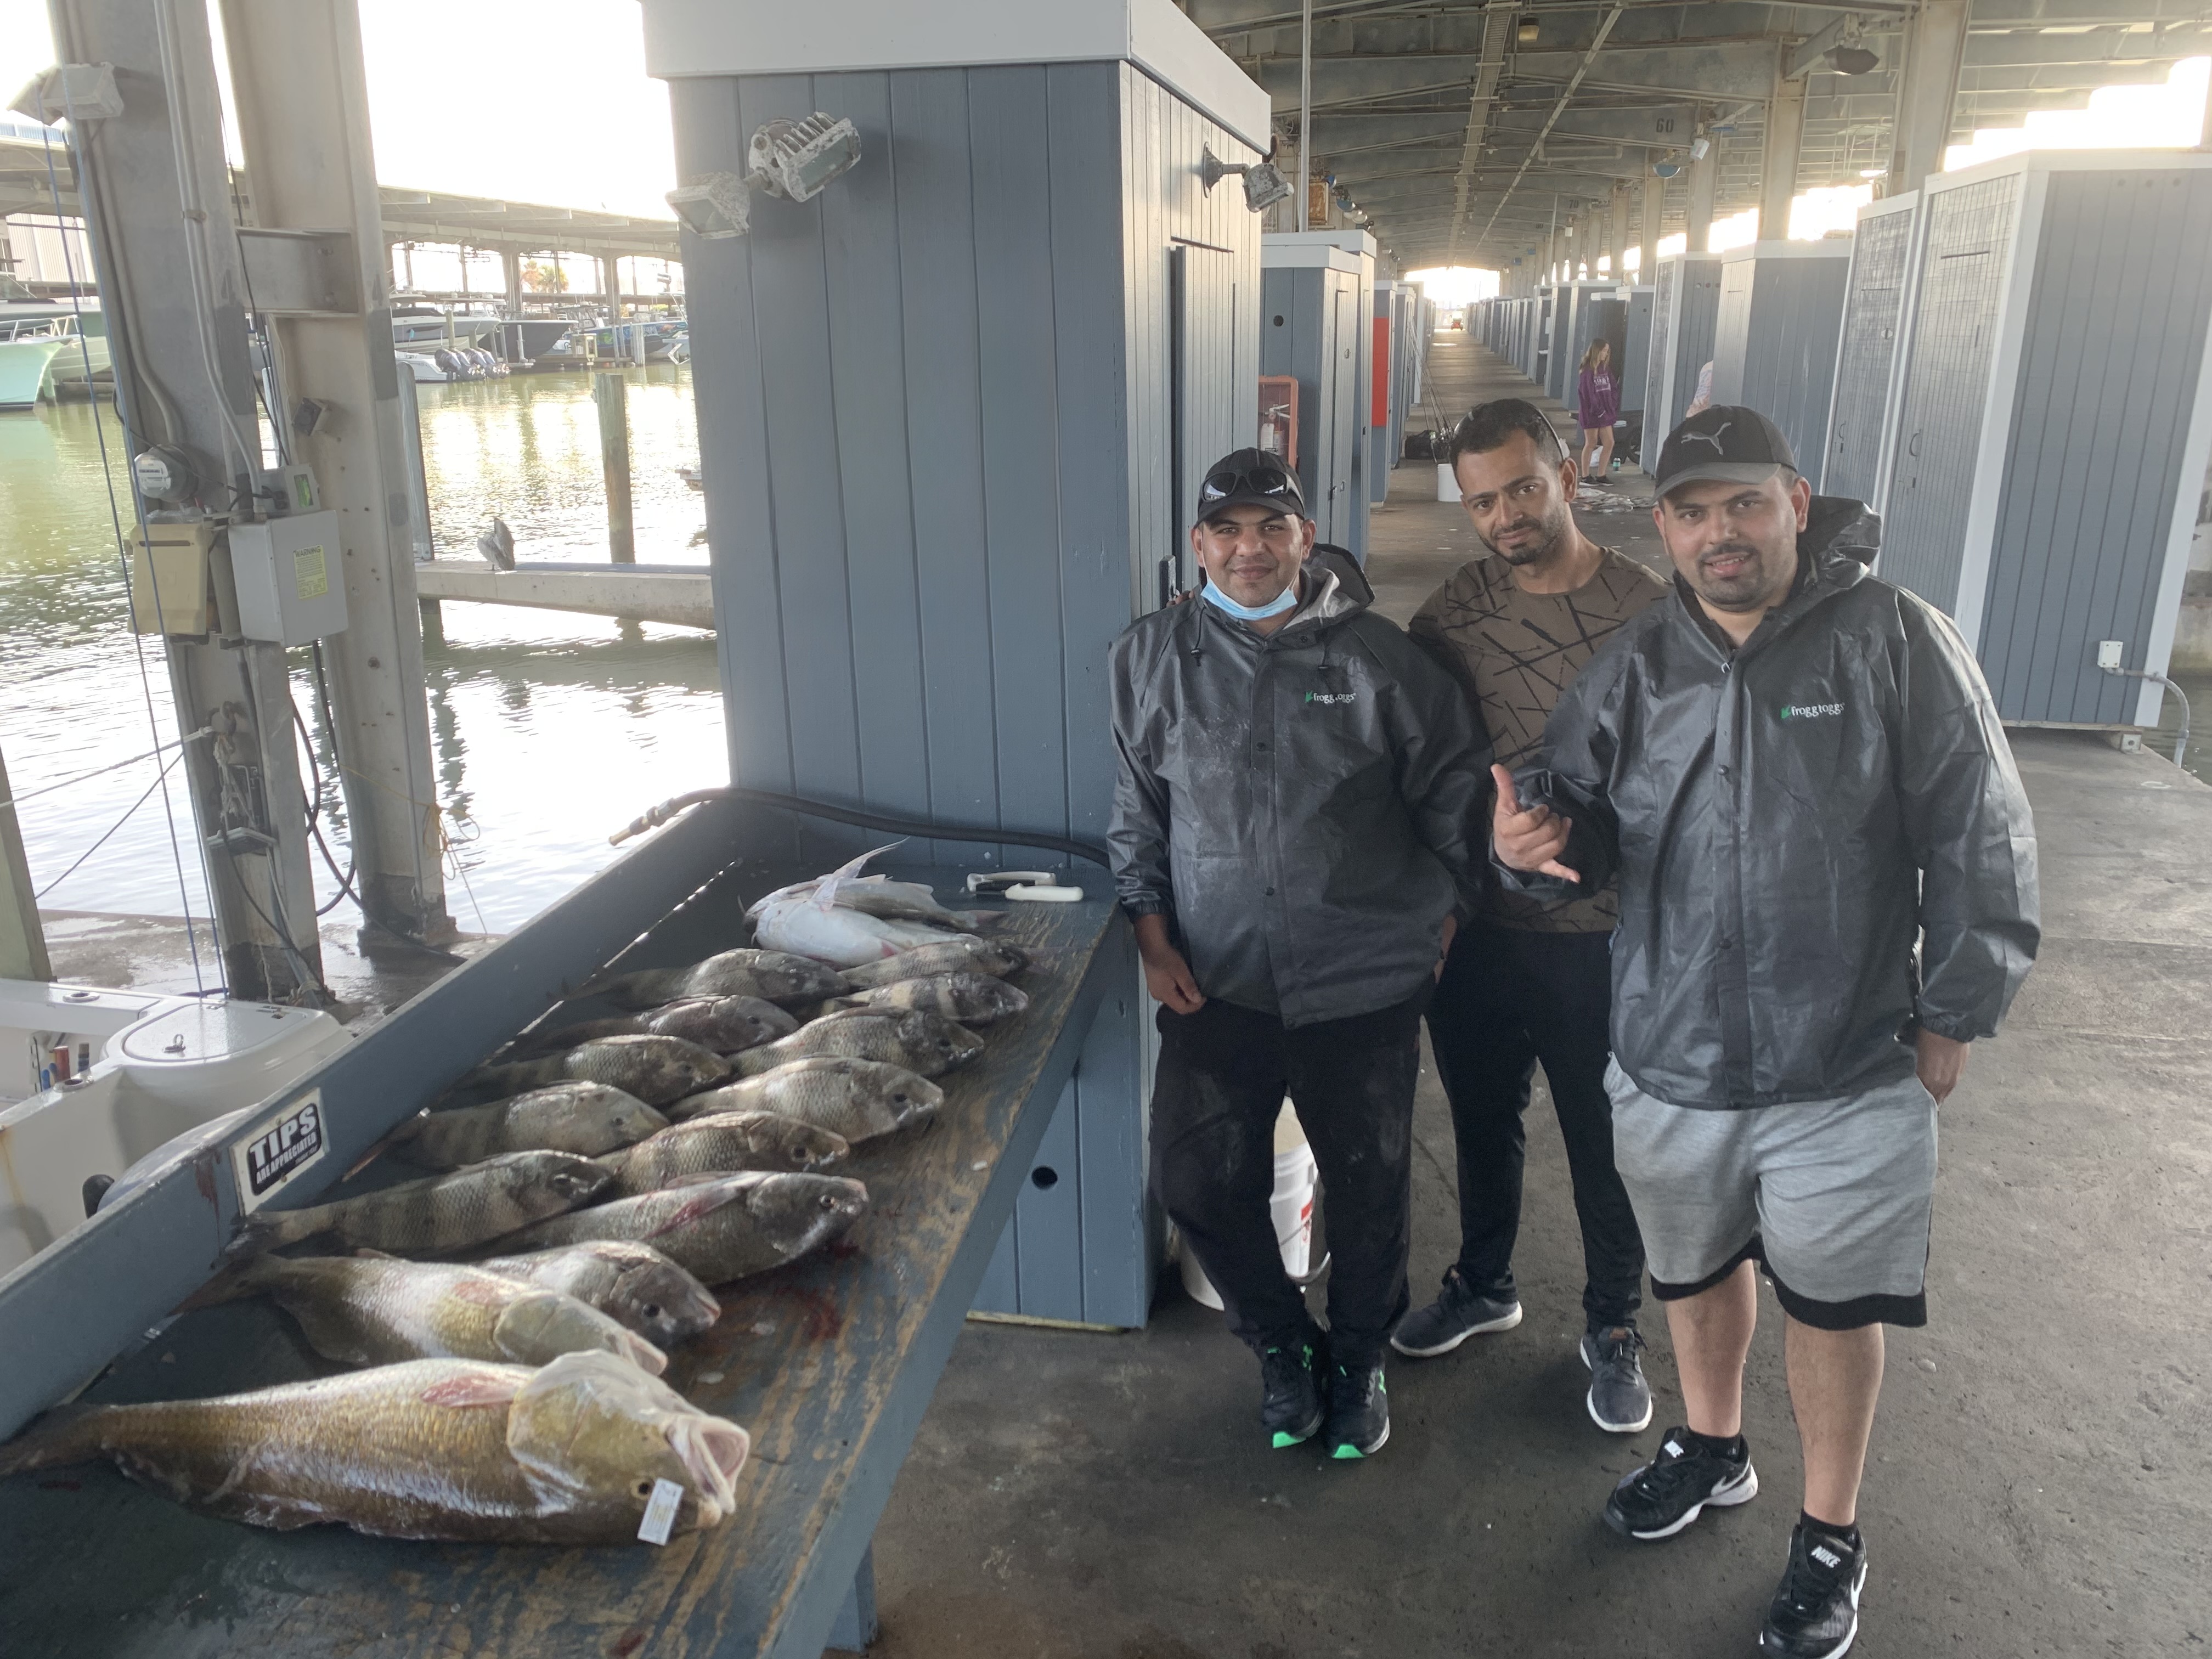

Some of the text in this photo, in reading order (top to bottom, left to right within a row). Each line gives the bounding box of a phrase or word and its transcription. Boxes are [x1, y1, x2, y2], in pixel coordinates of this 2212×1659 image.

[1656, 117, 1674, 133] 60
[1568, 199, 1579, 208] 70
[295, 545, 321, 557] WARNING
[250, 1107, 317, 1169] TIPS
[256, 1164, 270, 1184] ARE
[270, 1131, 317, 1174] APPRECIATED
[1811, 1545, 1841, 1568] NIKE
